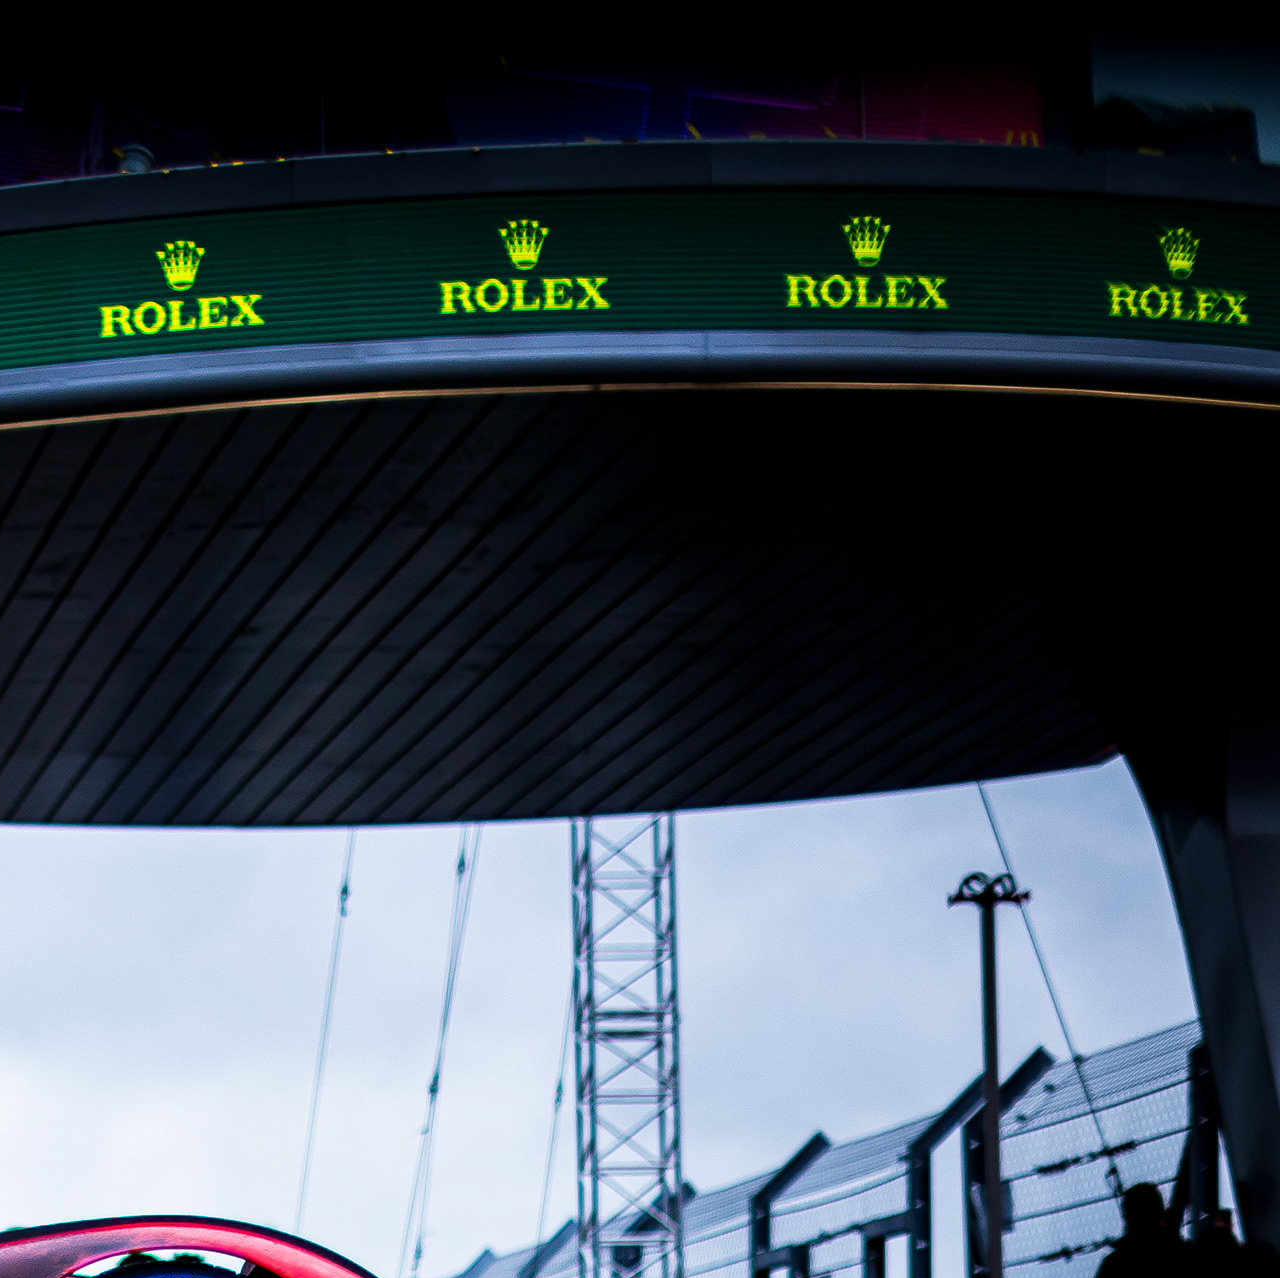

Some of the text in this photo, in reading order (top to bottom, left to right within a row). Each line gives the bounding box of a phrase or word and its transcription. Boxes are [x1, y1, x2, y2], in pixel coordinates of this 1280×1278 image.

[440, 276, 610, 314] ROLEX
[786, 273, 948, 310] ROLEX
[1109, 283, 1249, 325] ROLEX
[100, 293, 265, 337] ROLEX
